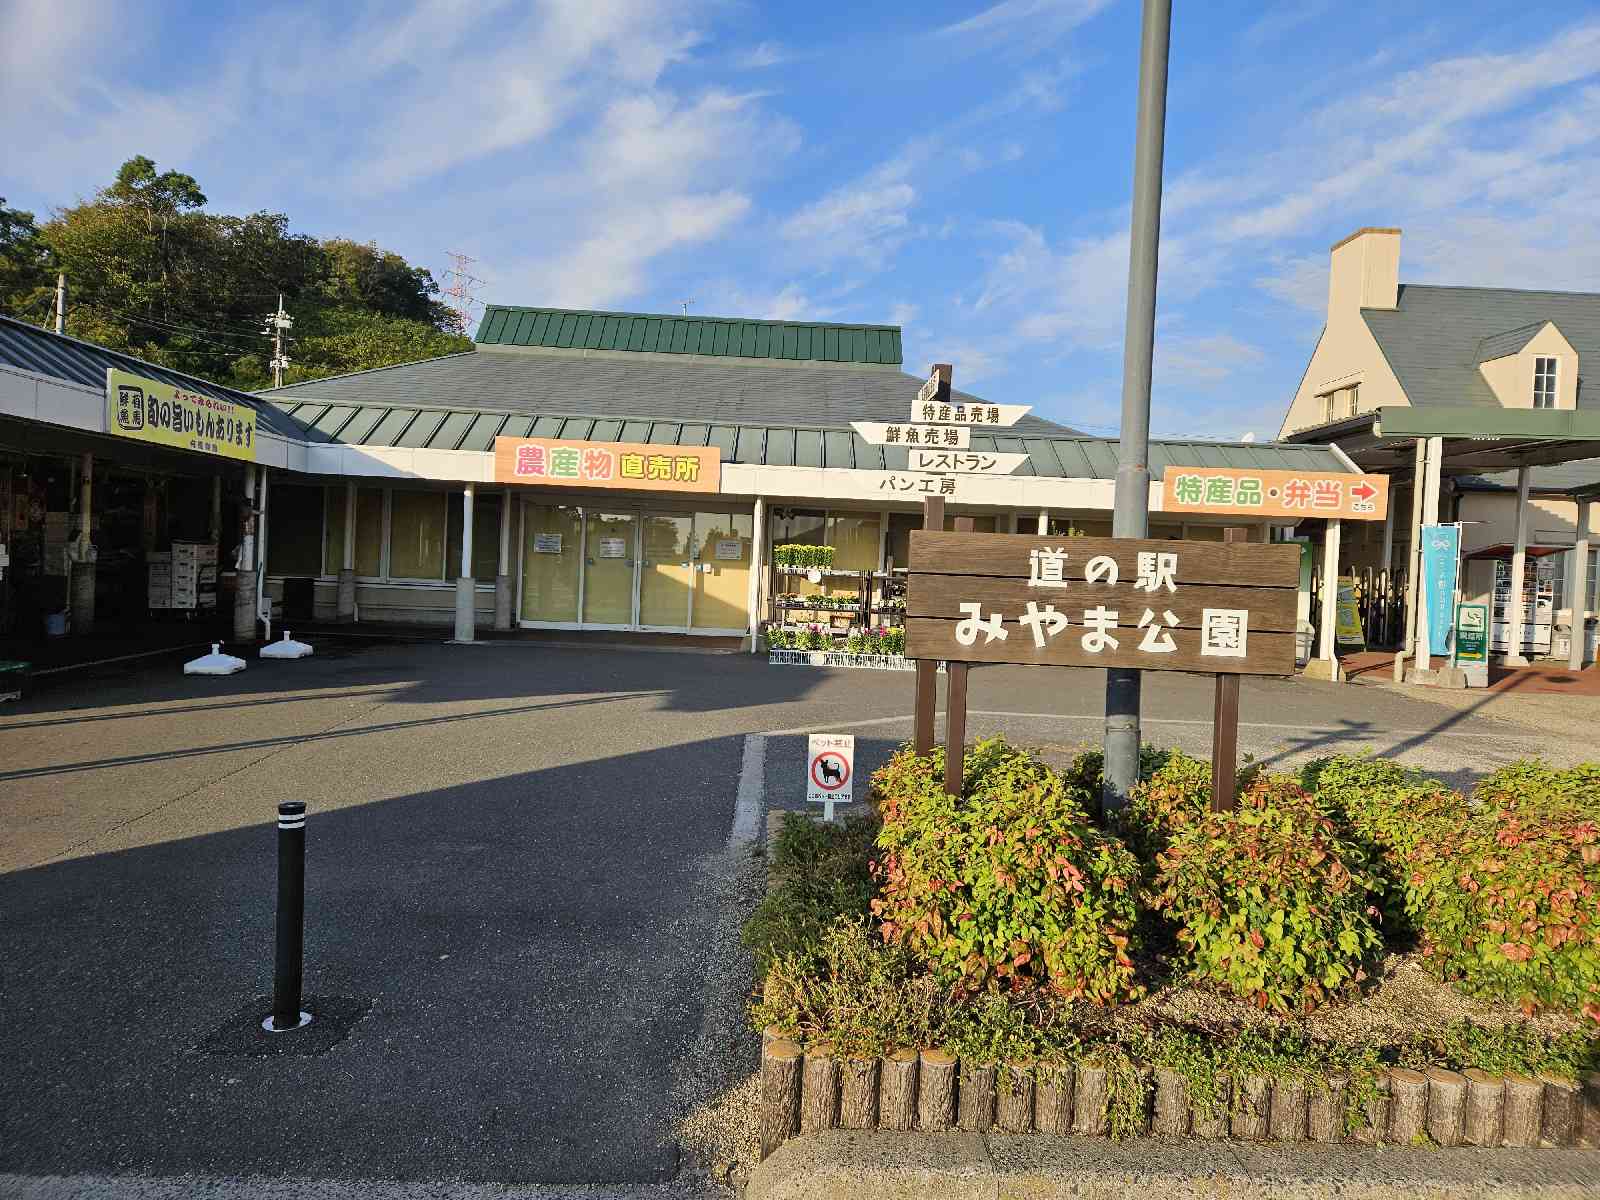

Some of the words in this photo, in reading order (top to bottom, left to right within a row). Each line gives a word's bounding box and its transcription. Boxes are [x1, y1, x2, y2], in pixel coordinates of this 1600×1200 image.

[147, 395, 252, 448] 旬の旨いもんあります
[922, 404, 1000, 424] 特産品売場
[886, 426, 959, 446] 鮮魚売場
[515, 444, 701, 482] 農産物直売所
[919, 453, 997, 470] レストラン
[879, 475, 956, 495] パン工房
[1176, 475, 1343, 509] 特産品・弁当
[1353, 503, 1375, 511] こちら
[1028, 547, 1178, 592] 道の駅
[955, 601, 1248, 657] みやま公園
